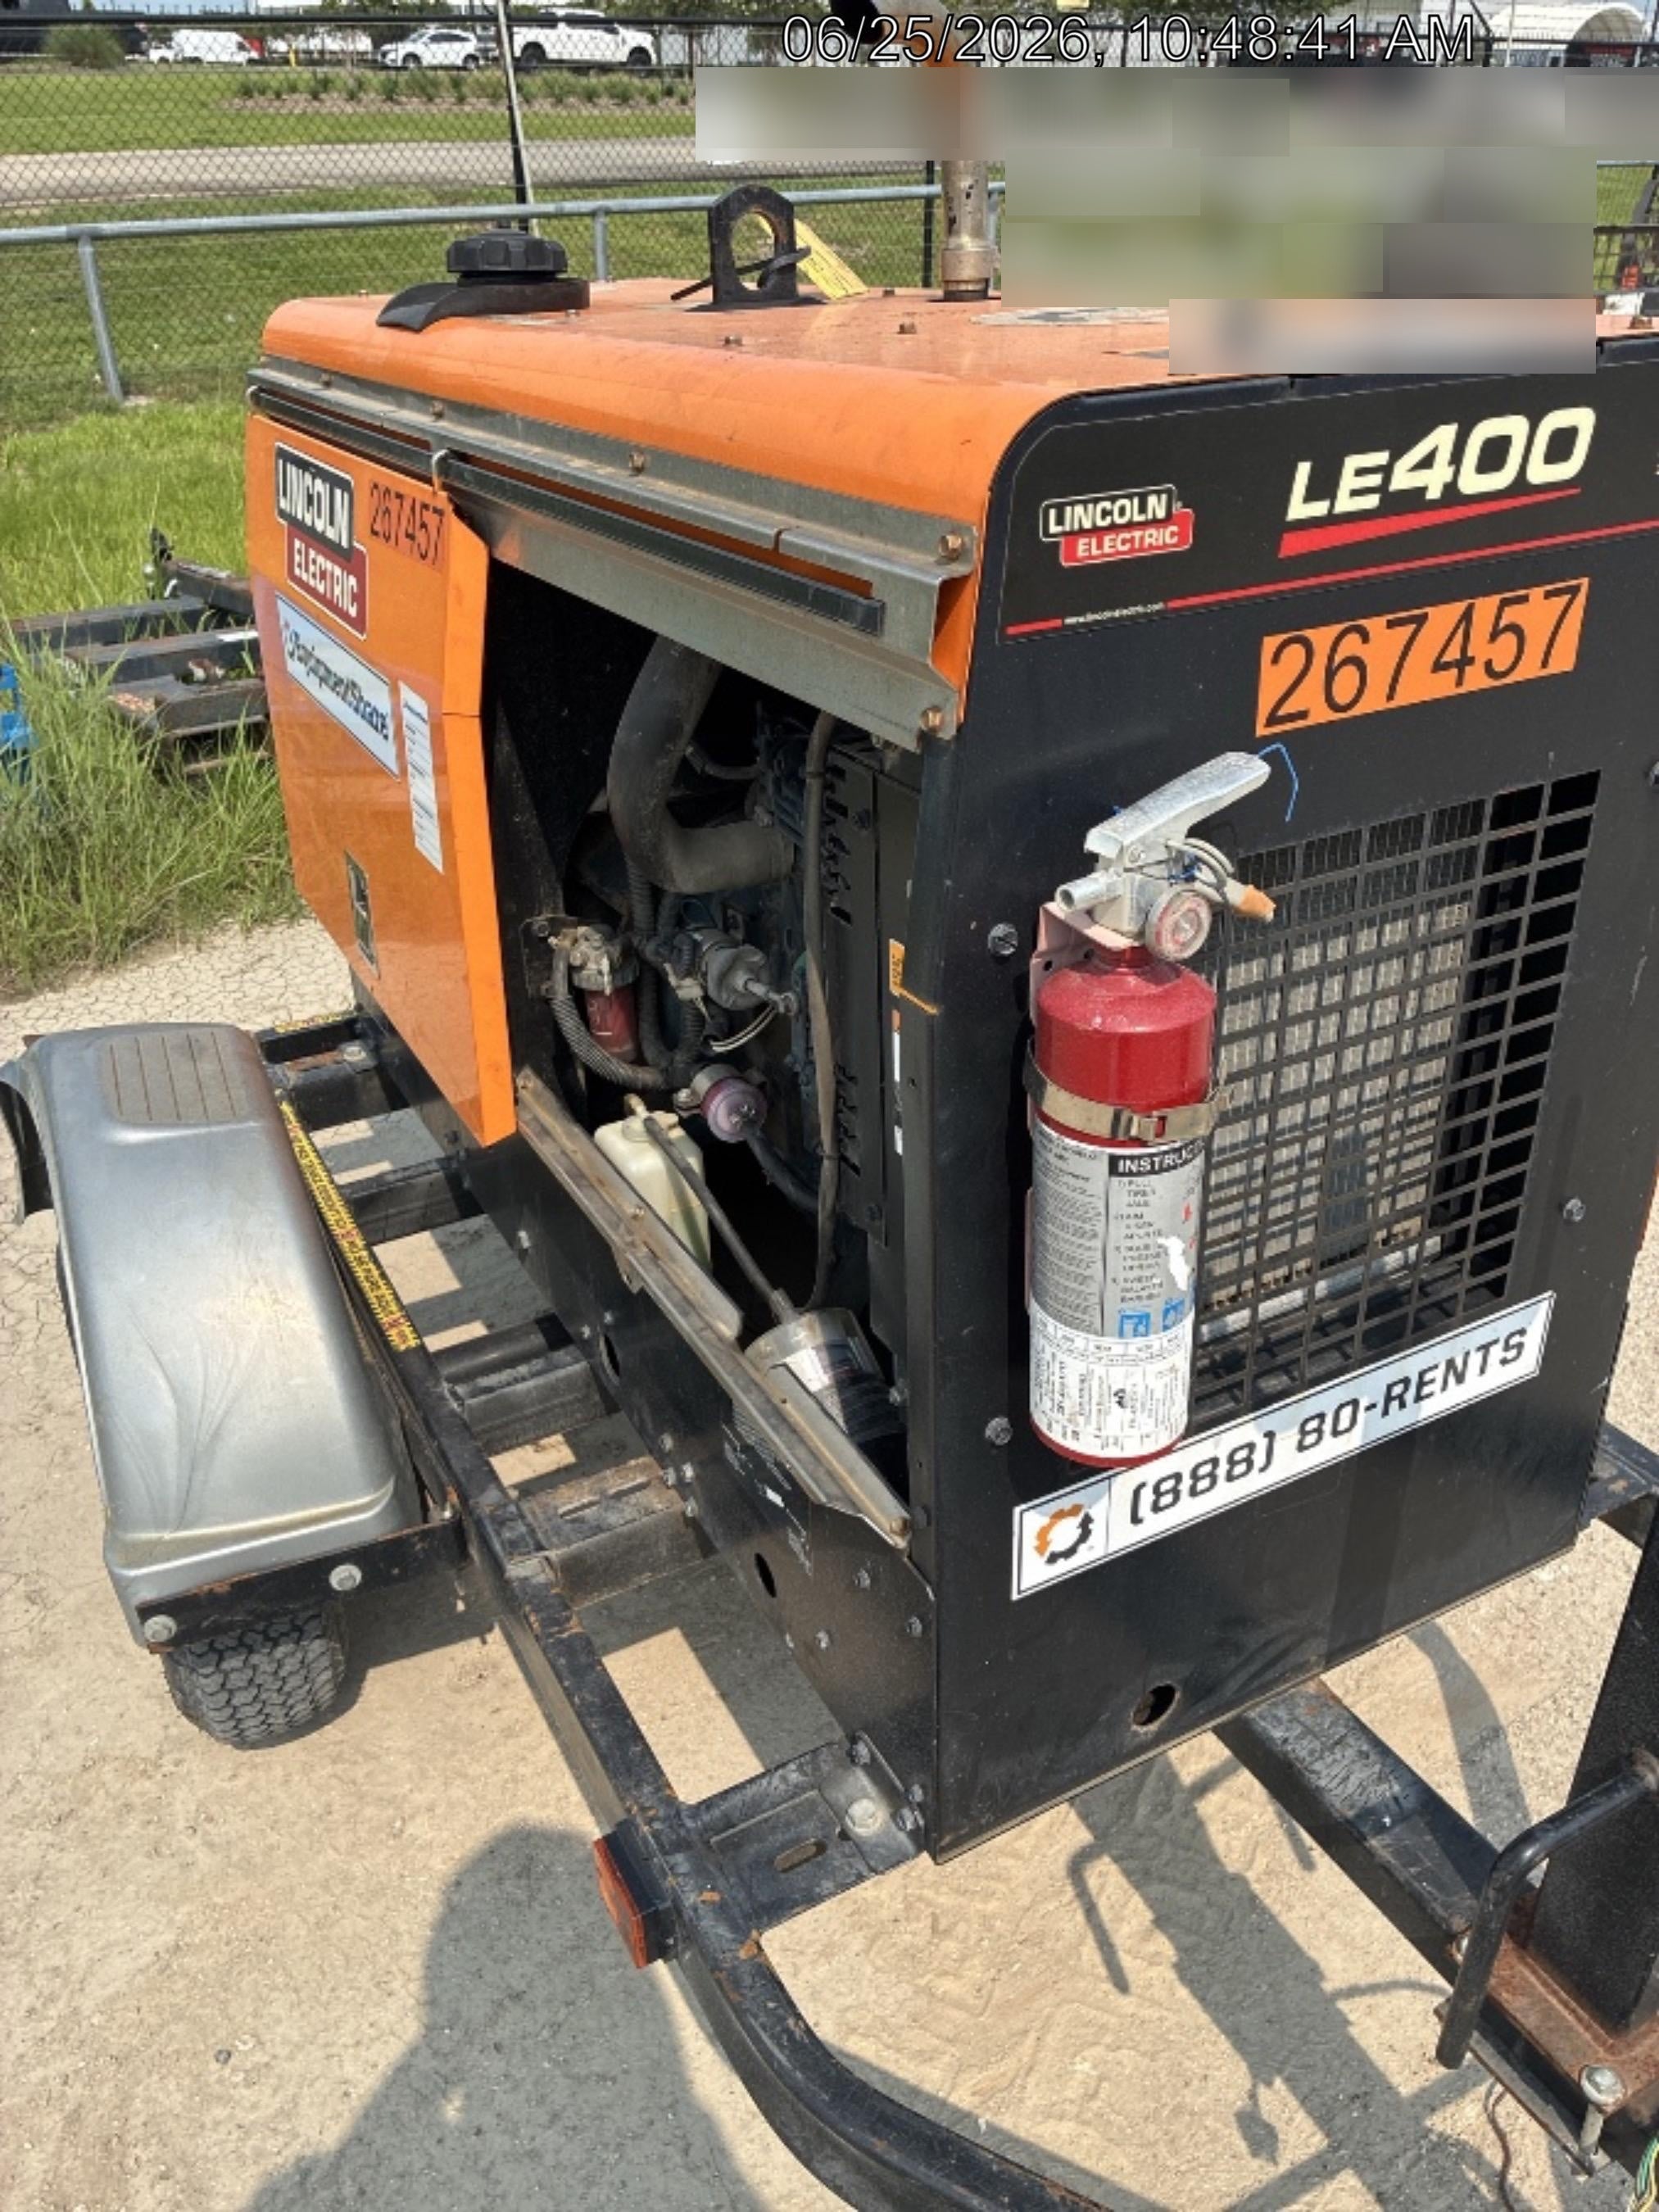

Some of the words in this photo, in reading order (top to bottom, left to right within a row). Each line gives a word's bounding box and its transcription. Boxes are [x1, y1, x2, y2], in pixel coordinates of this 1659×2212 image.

[278, 459, 350, 549] LINCOLN
[1285, 406, 1596, 522] LE400
[369, 480, 445, 566] 267457
[1049, 493, 1169, 534] LINCOLN
[1077, 525, 1179, 557] ELECTRIC
[293, 537, 358, 618] ELECTRIC
[1264, 582, 1583, 729] 267457
[1131, 1430, 1274, 1525] (888)
[1296, 1326, 1526, 1453] 80-RENTS
